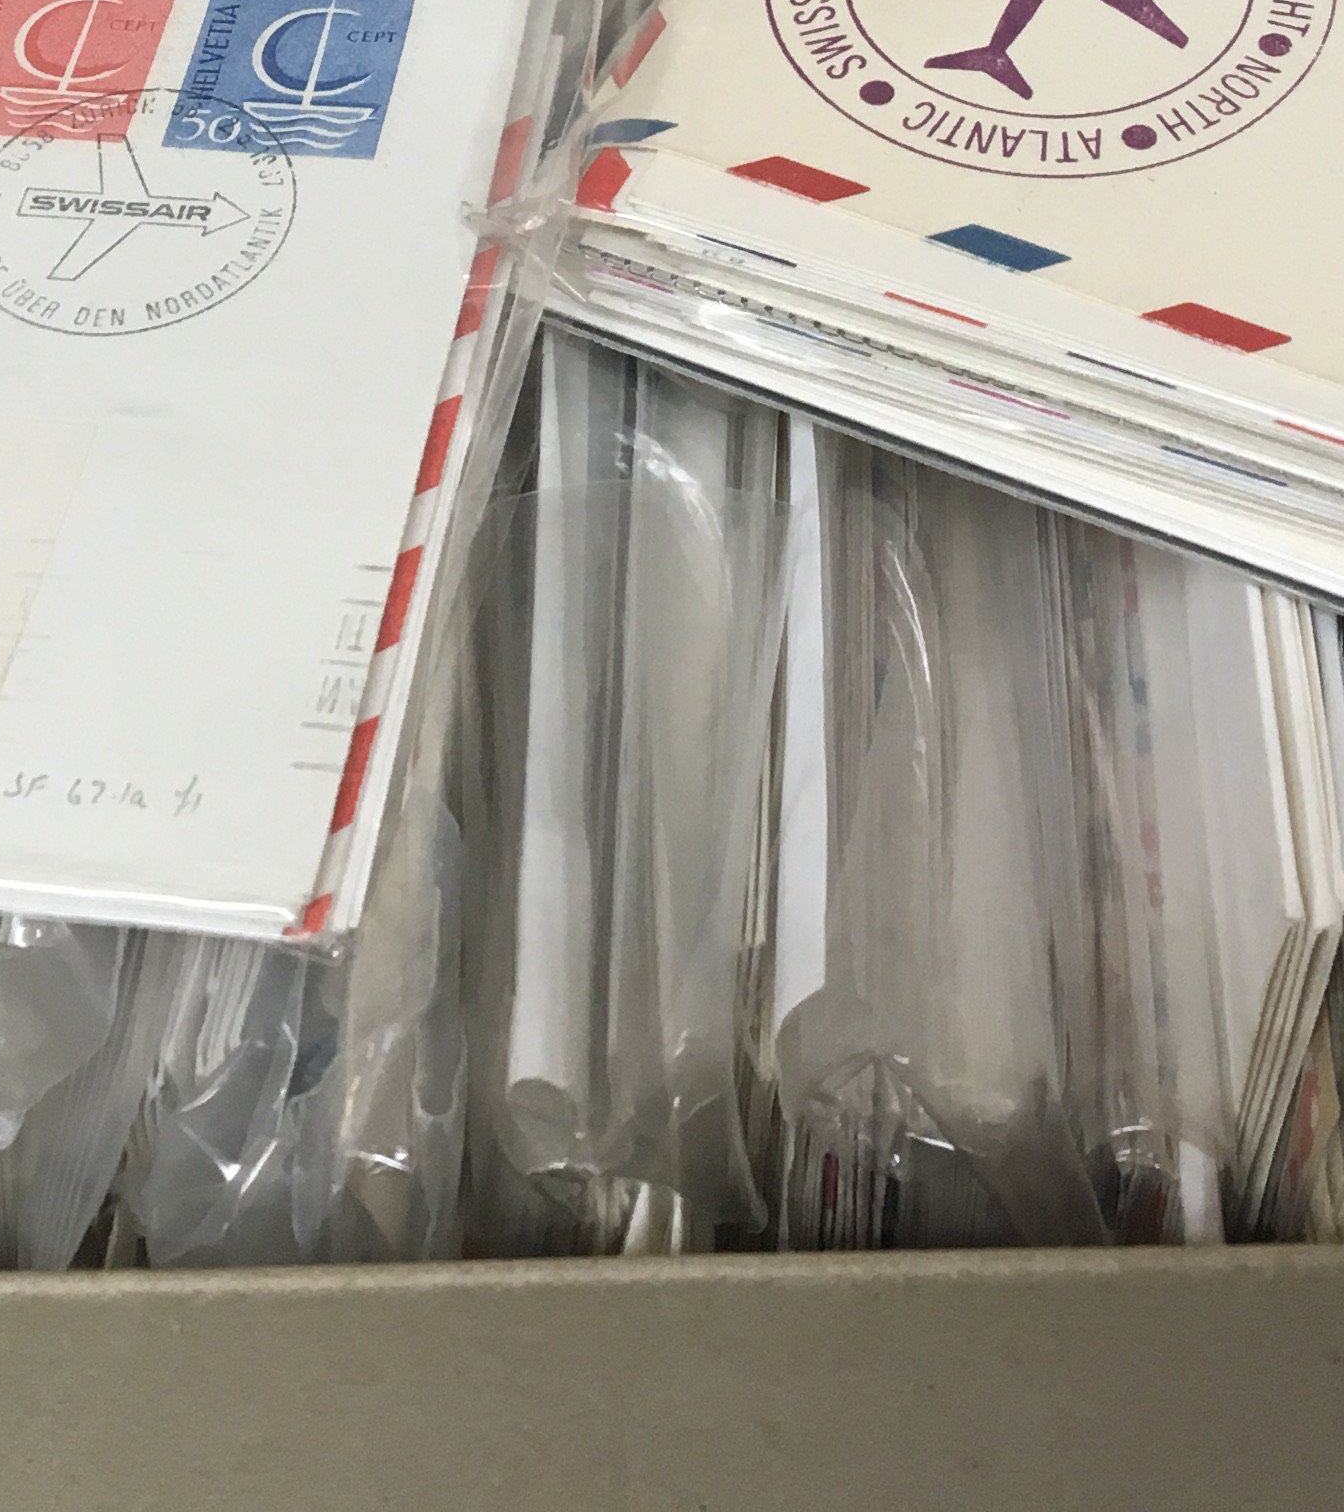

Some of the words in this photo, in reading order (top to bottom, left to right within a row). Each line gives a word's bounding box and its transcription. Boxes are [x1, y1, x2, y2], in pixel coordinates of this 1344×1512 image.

[109, 18, 158, 33] CEPT
[346, 30, 398, 44] CEPT
[187, 3, 242, 102] HELVETIA
[1156, 55, 1283, 143] NORTH
[175, 109, 242, 145] 50
[902, 100, 1103, 164] ATLANTIC
[29, 195, 212, 221] SWISSAIR
[1, 278, 60, 319] ÜBER
[74, 307, 126, 327] DEN
[145, 207, 283, 321] NORDATLANTIK
